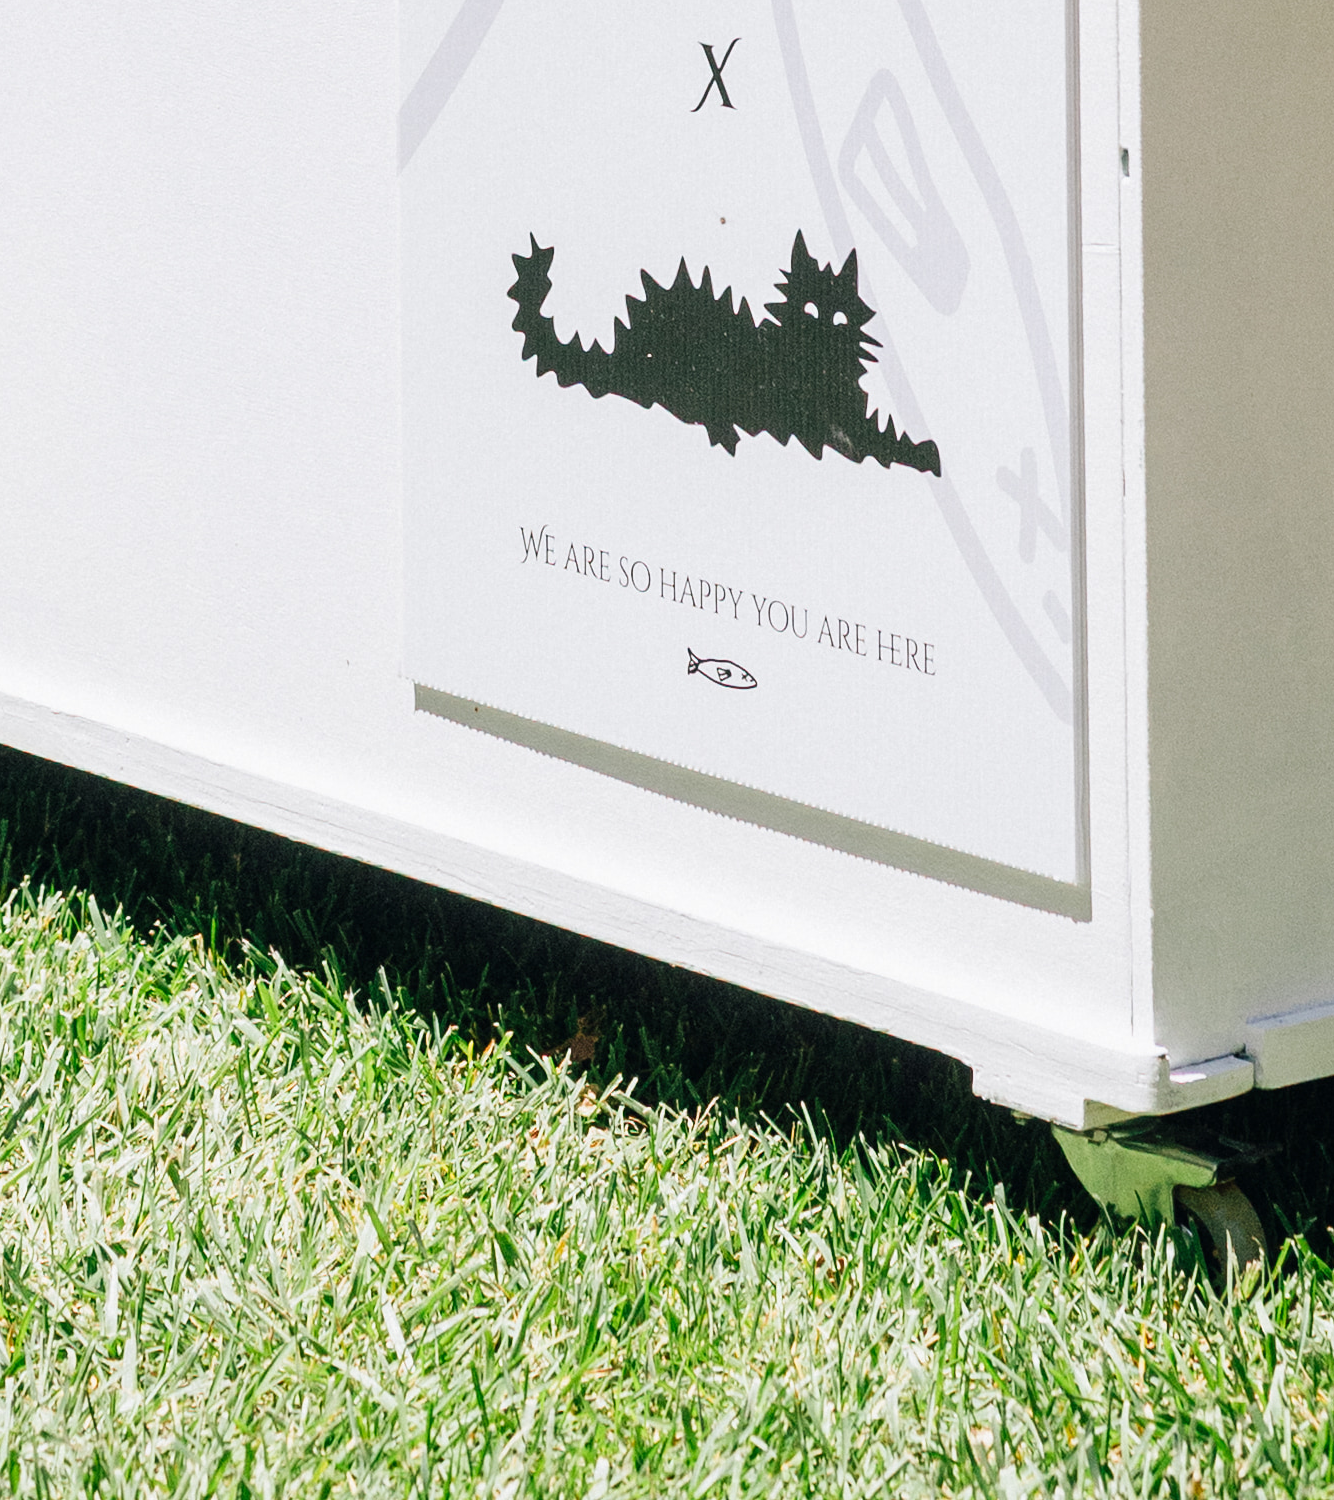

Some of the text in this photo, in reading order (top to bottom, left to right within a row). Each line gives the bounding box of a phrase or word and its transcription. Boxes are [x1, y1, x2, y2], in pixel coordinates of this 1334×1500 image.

[563, 542, 611, 583] ARE
[618, 555, 652, 593] SO
[660, 567, 745, 621] HAPPY
[751, 594, 809, 640] YOU
[818, 615, 866, 657] ARE
[877, 629, 936, 676] HERE
